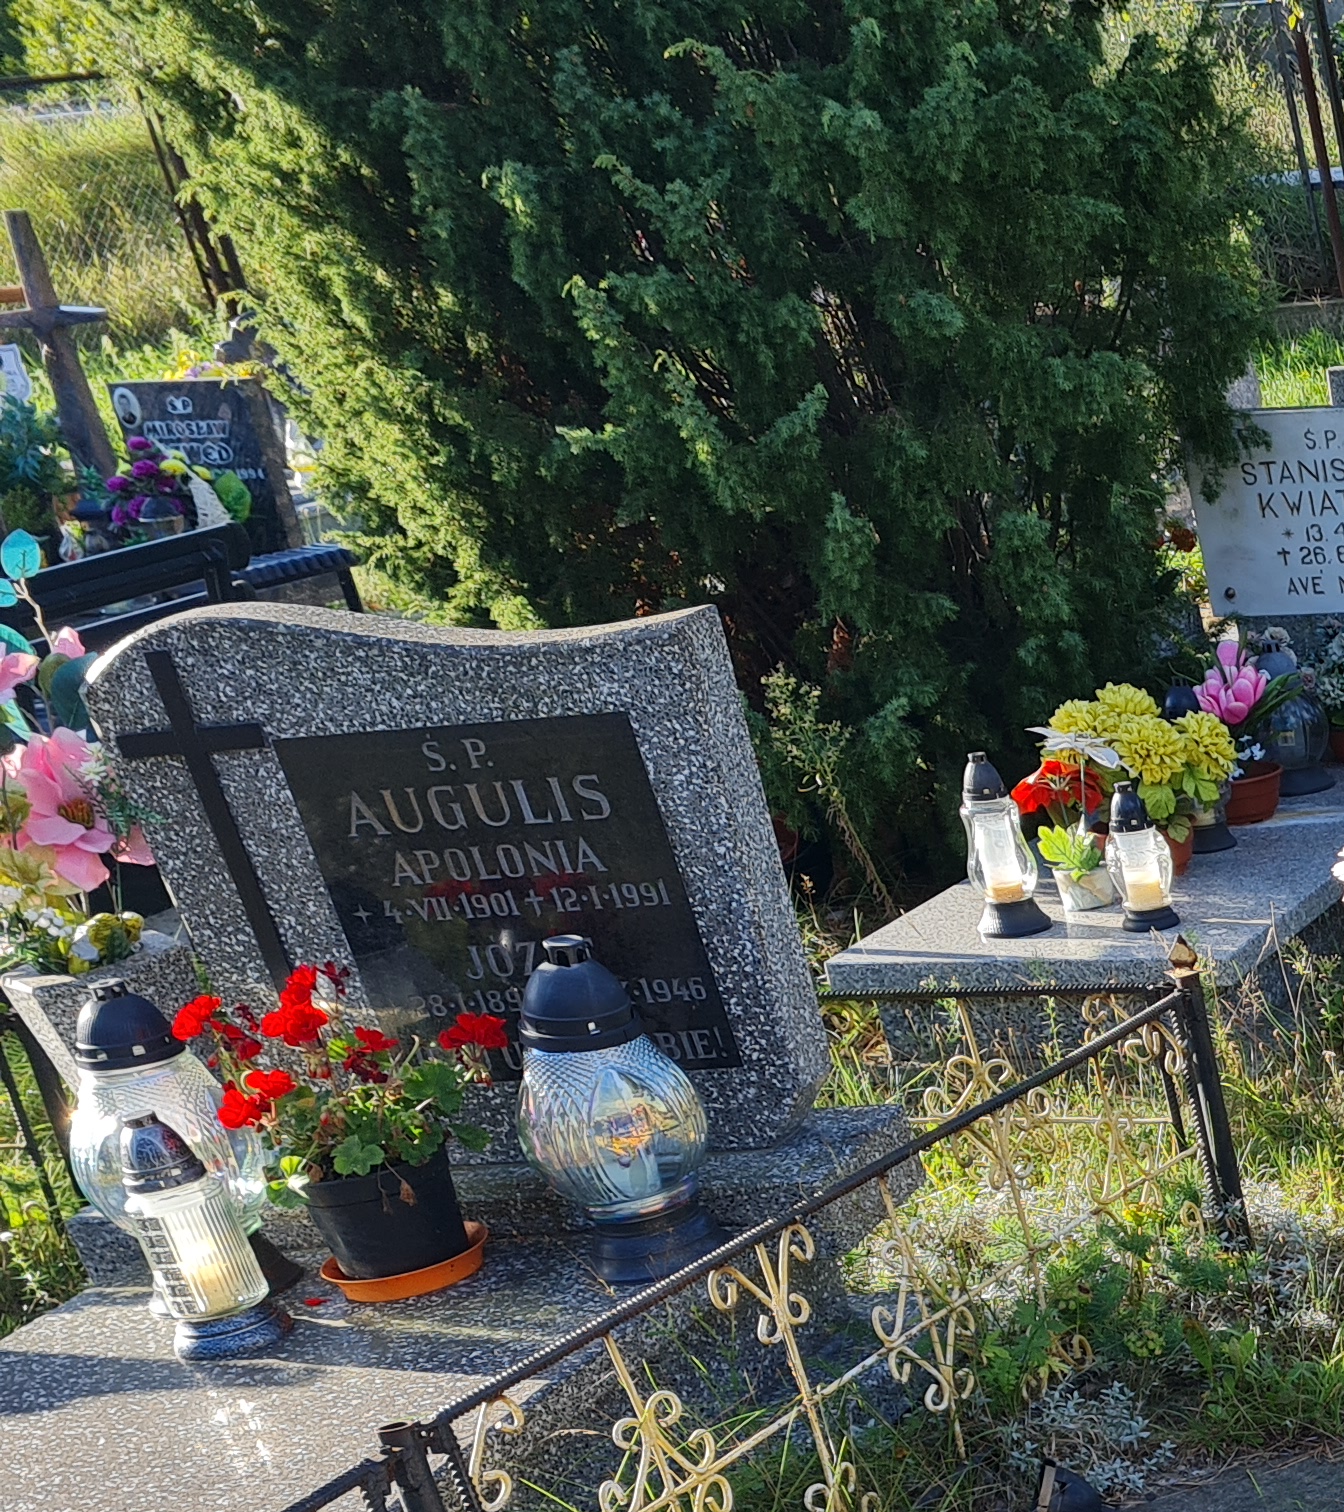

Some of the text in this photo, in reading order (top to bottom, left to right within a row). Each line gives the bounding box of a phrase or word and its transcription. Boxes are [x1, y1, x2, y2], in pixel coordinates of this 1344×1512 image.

[1287, 576, 1325, 595] AVE
[348, 774, 612, 838] AUGULIS
[391, 836, 609, 888] APOLONIA
